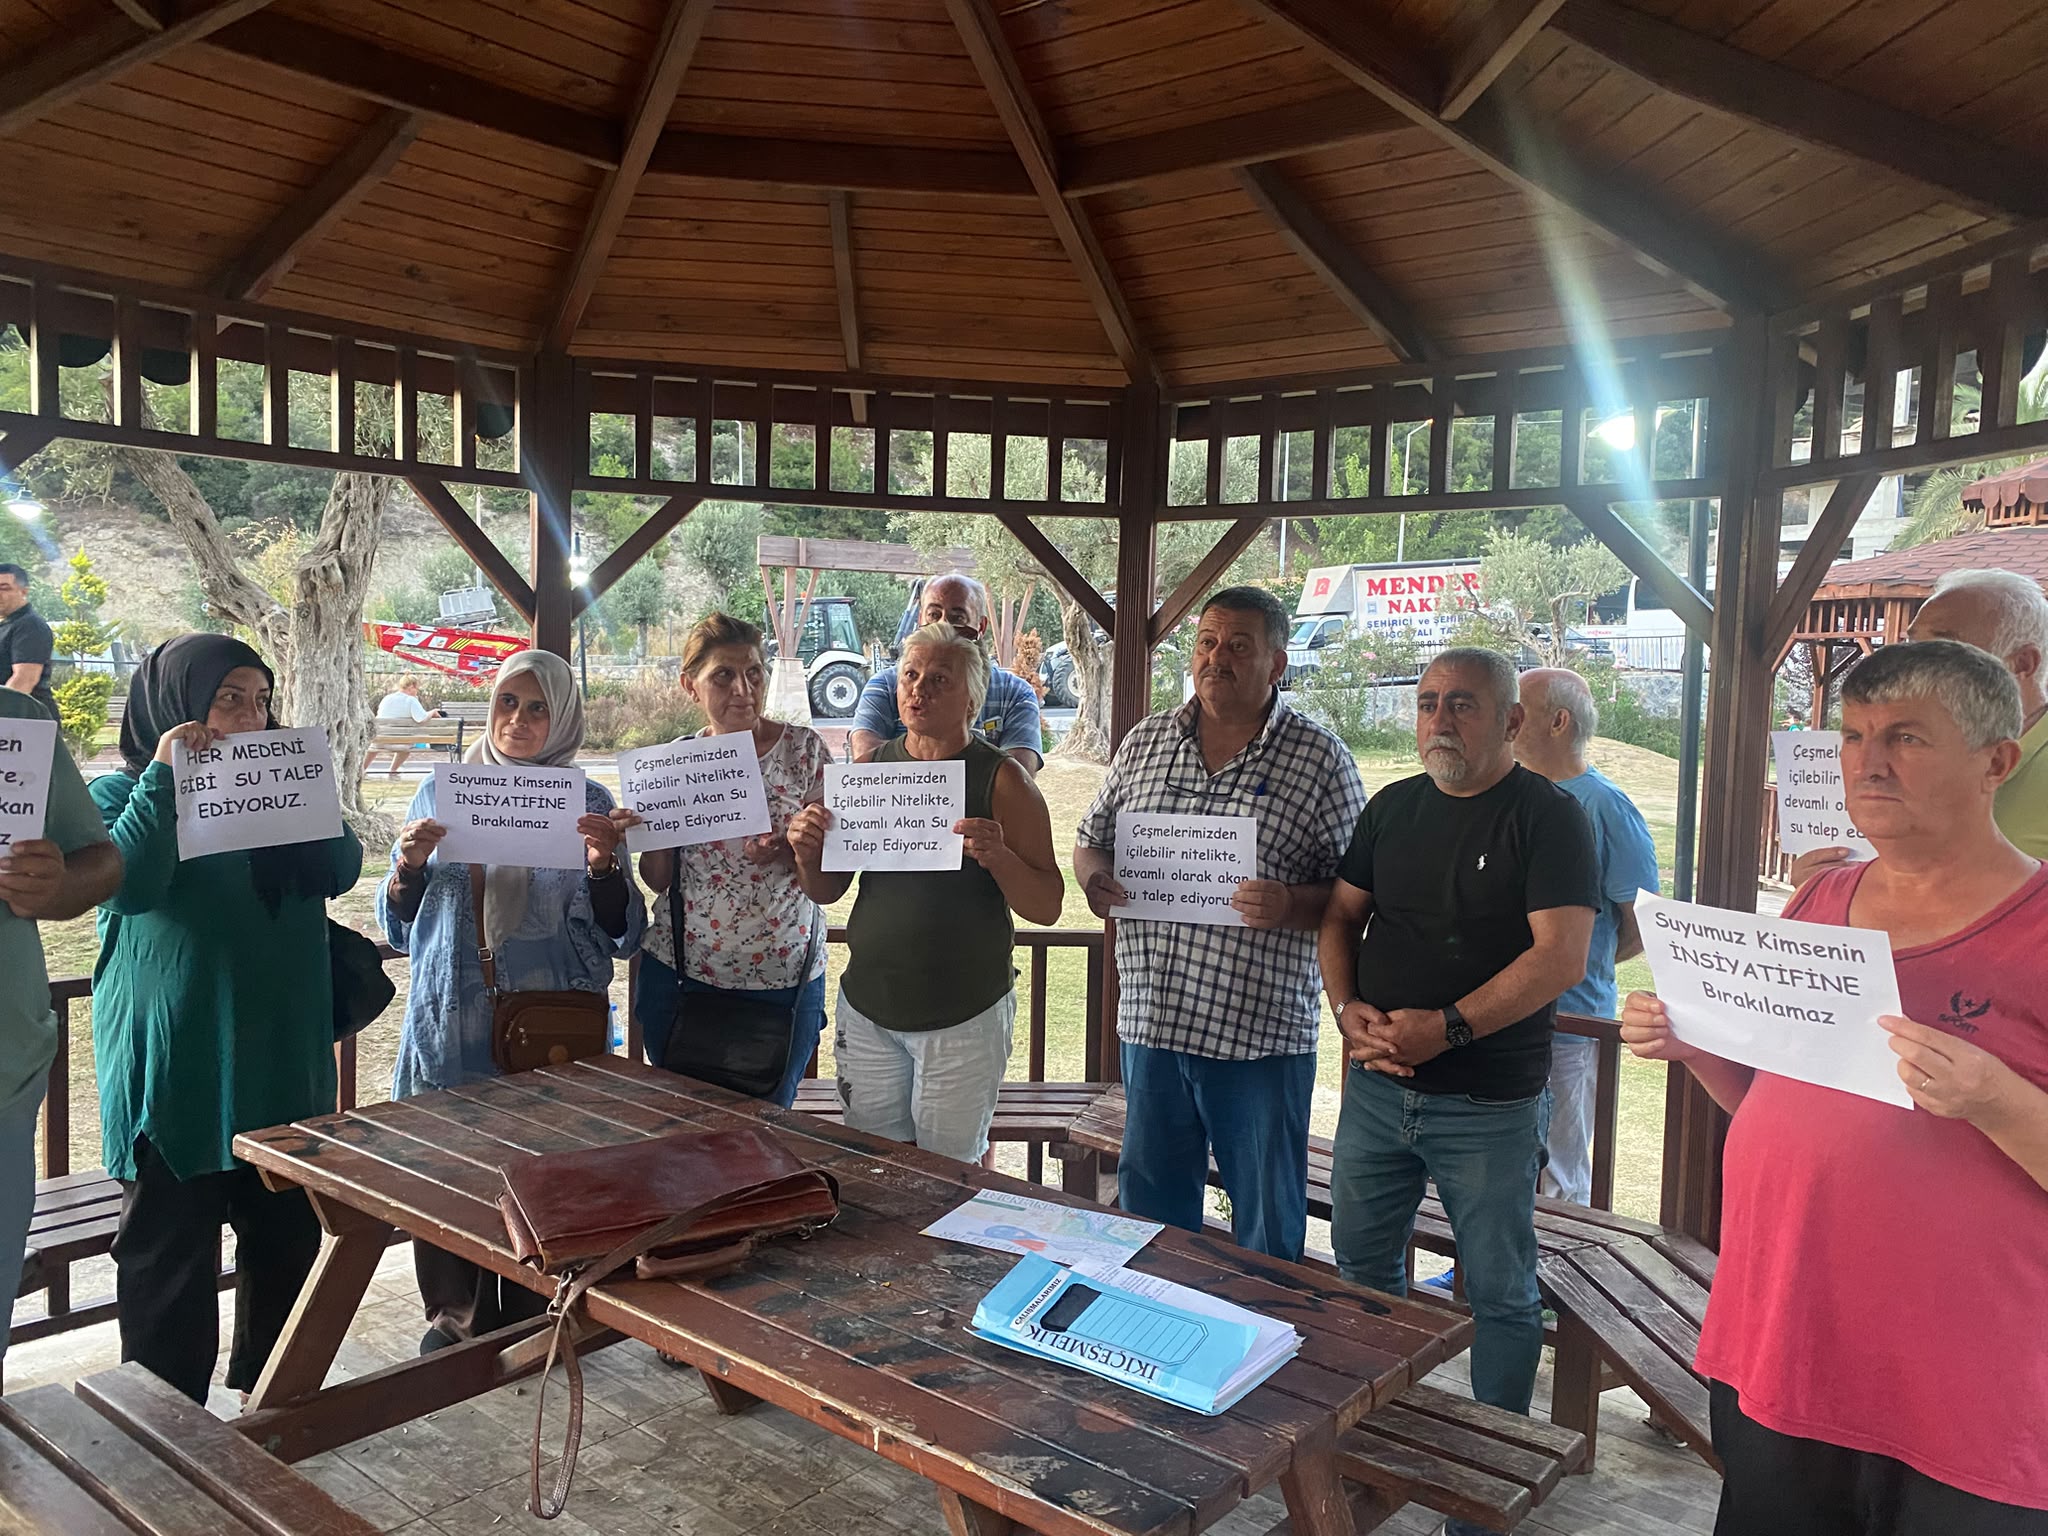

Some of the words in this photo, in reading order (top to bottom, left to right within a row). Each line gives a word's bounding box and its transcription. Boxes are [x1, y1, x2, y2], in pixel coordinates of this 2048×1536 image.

[186, 748, 223, 766] HER
[232, 737, 306, 761] MEDENİ
[634, 748, 738, 773] Çeşmelerimizden
[180, 772, 217, 795] GİBİ
[234, 771, 261, 787] SU
[269, 763, 324, 783] TALEP
[448, 773, 507, 788] Suyumuz
[513, 776, 572, 789] Kimsenin
[628, 776, 681, 794] İçilebilir
[685, 768, 750, 785] Nitelikte,
[841, 771, 947, 788] Çeşmelerimizden
[1789, 769, 1841, 786] içilebilir
[198, 793, 307, 819] EDİYORUZ.
[455, 791, 566, 810] İNSİYATİFİNE
[636, 796, 686, 813] Devamlı
[692, 792, 725, 805] Akan
[730, 788, 747, 800] Su
[832, 794, 886, 810] İçilebilir
[891, 793, 955, 808] Nitelikte,
[1784, 794, 1828, 810] devamlı
[471, 814, 549, 829] Bırakılamaz
[643, 818, 680, 832] Talep
[685, 811, 746, 828] Ediyoruz.
[840, 816, 888, 830] Devamlı
[894, 816, 925, 829] Akan
[931, 816, 948, 828] Su
[1790, 822, 1803, 833] su
[1807, 821, 1839, 841] talep
[1132, 824, 1237, 840] Çeşmelerimizden
[843, 839, 878, 855] Talep
[883, 838, 943, 854] Ediyoruz.
[1126, 845, 1175, 859] içilebilir
[1181, 848, 1241, 864] nitelikte,
[1119, 866, 1164, 880] devamlı
[1171, 868, 1212, 882] olarak
[1123, 890, 1136, 900] su
[1142, 889, 1175, 905] talep
[1655, 912, 1747, 946] Suyumuz
[1756, 930, 1866, 963] Kimsenin
[1669, 940, 1861, 996] İNSİYATİFİNE
[1702, 981, 1836, 1025] Bırakılamaz
[1024, 1324, 1159, 1384] İKİÇEŞMELİK
